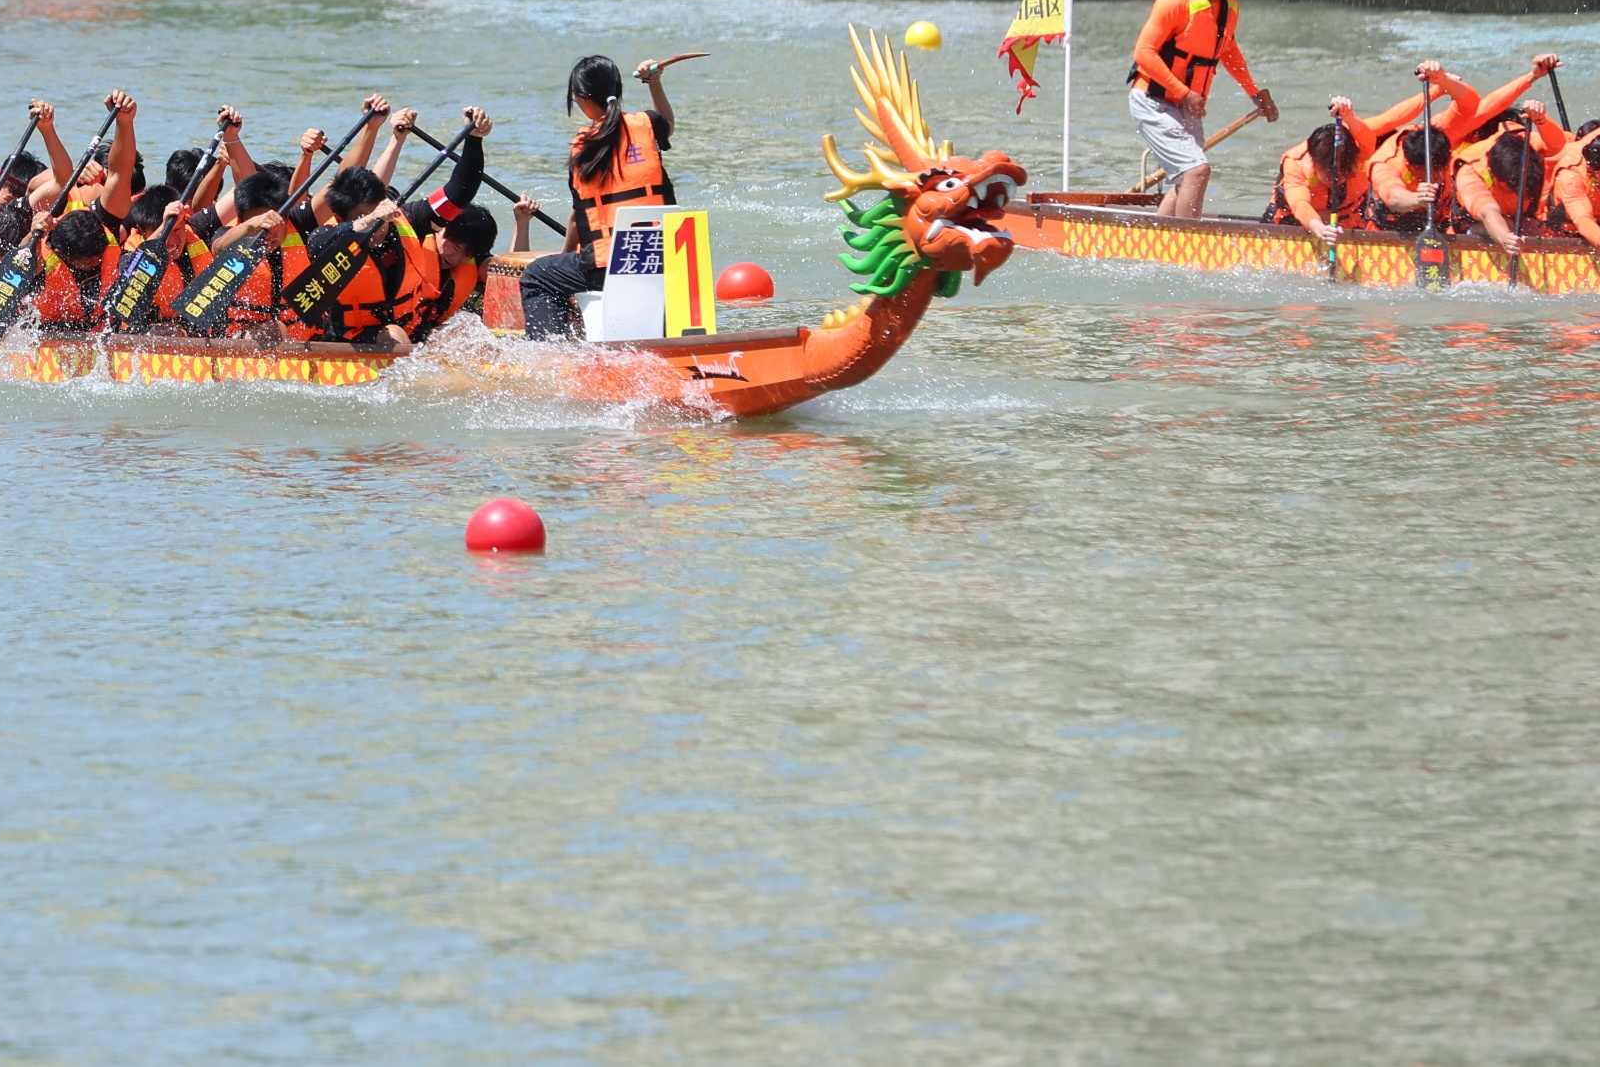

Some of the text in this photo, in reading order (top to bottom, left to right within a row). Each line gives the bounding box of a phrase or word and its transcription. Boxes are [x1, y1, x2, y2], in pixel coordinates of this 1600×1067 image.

[626, 144, 646, 165] 生
[621, 231, 664, 254] 培生
[616, 253, 663, 274] 龙舟
[675, 217, 702, 327] 1
